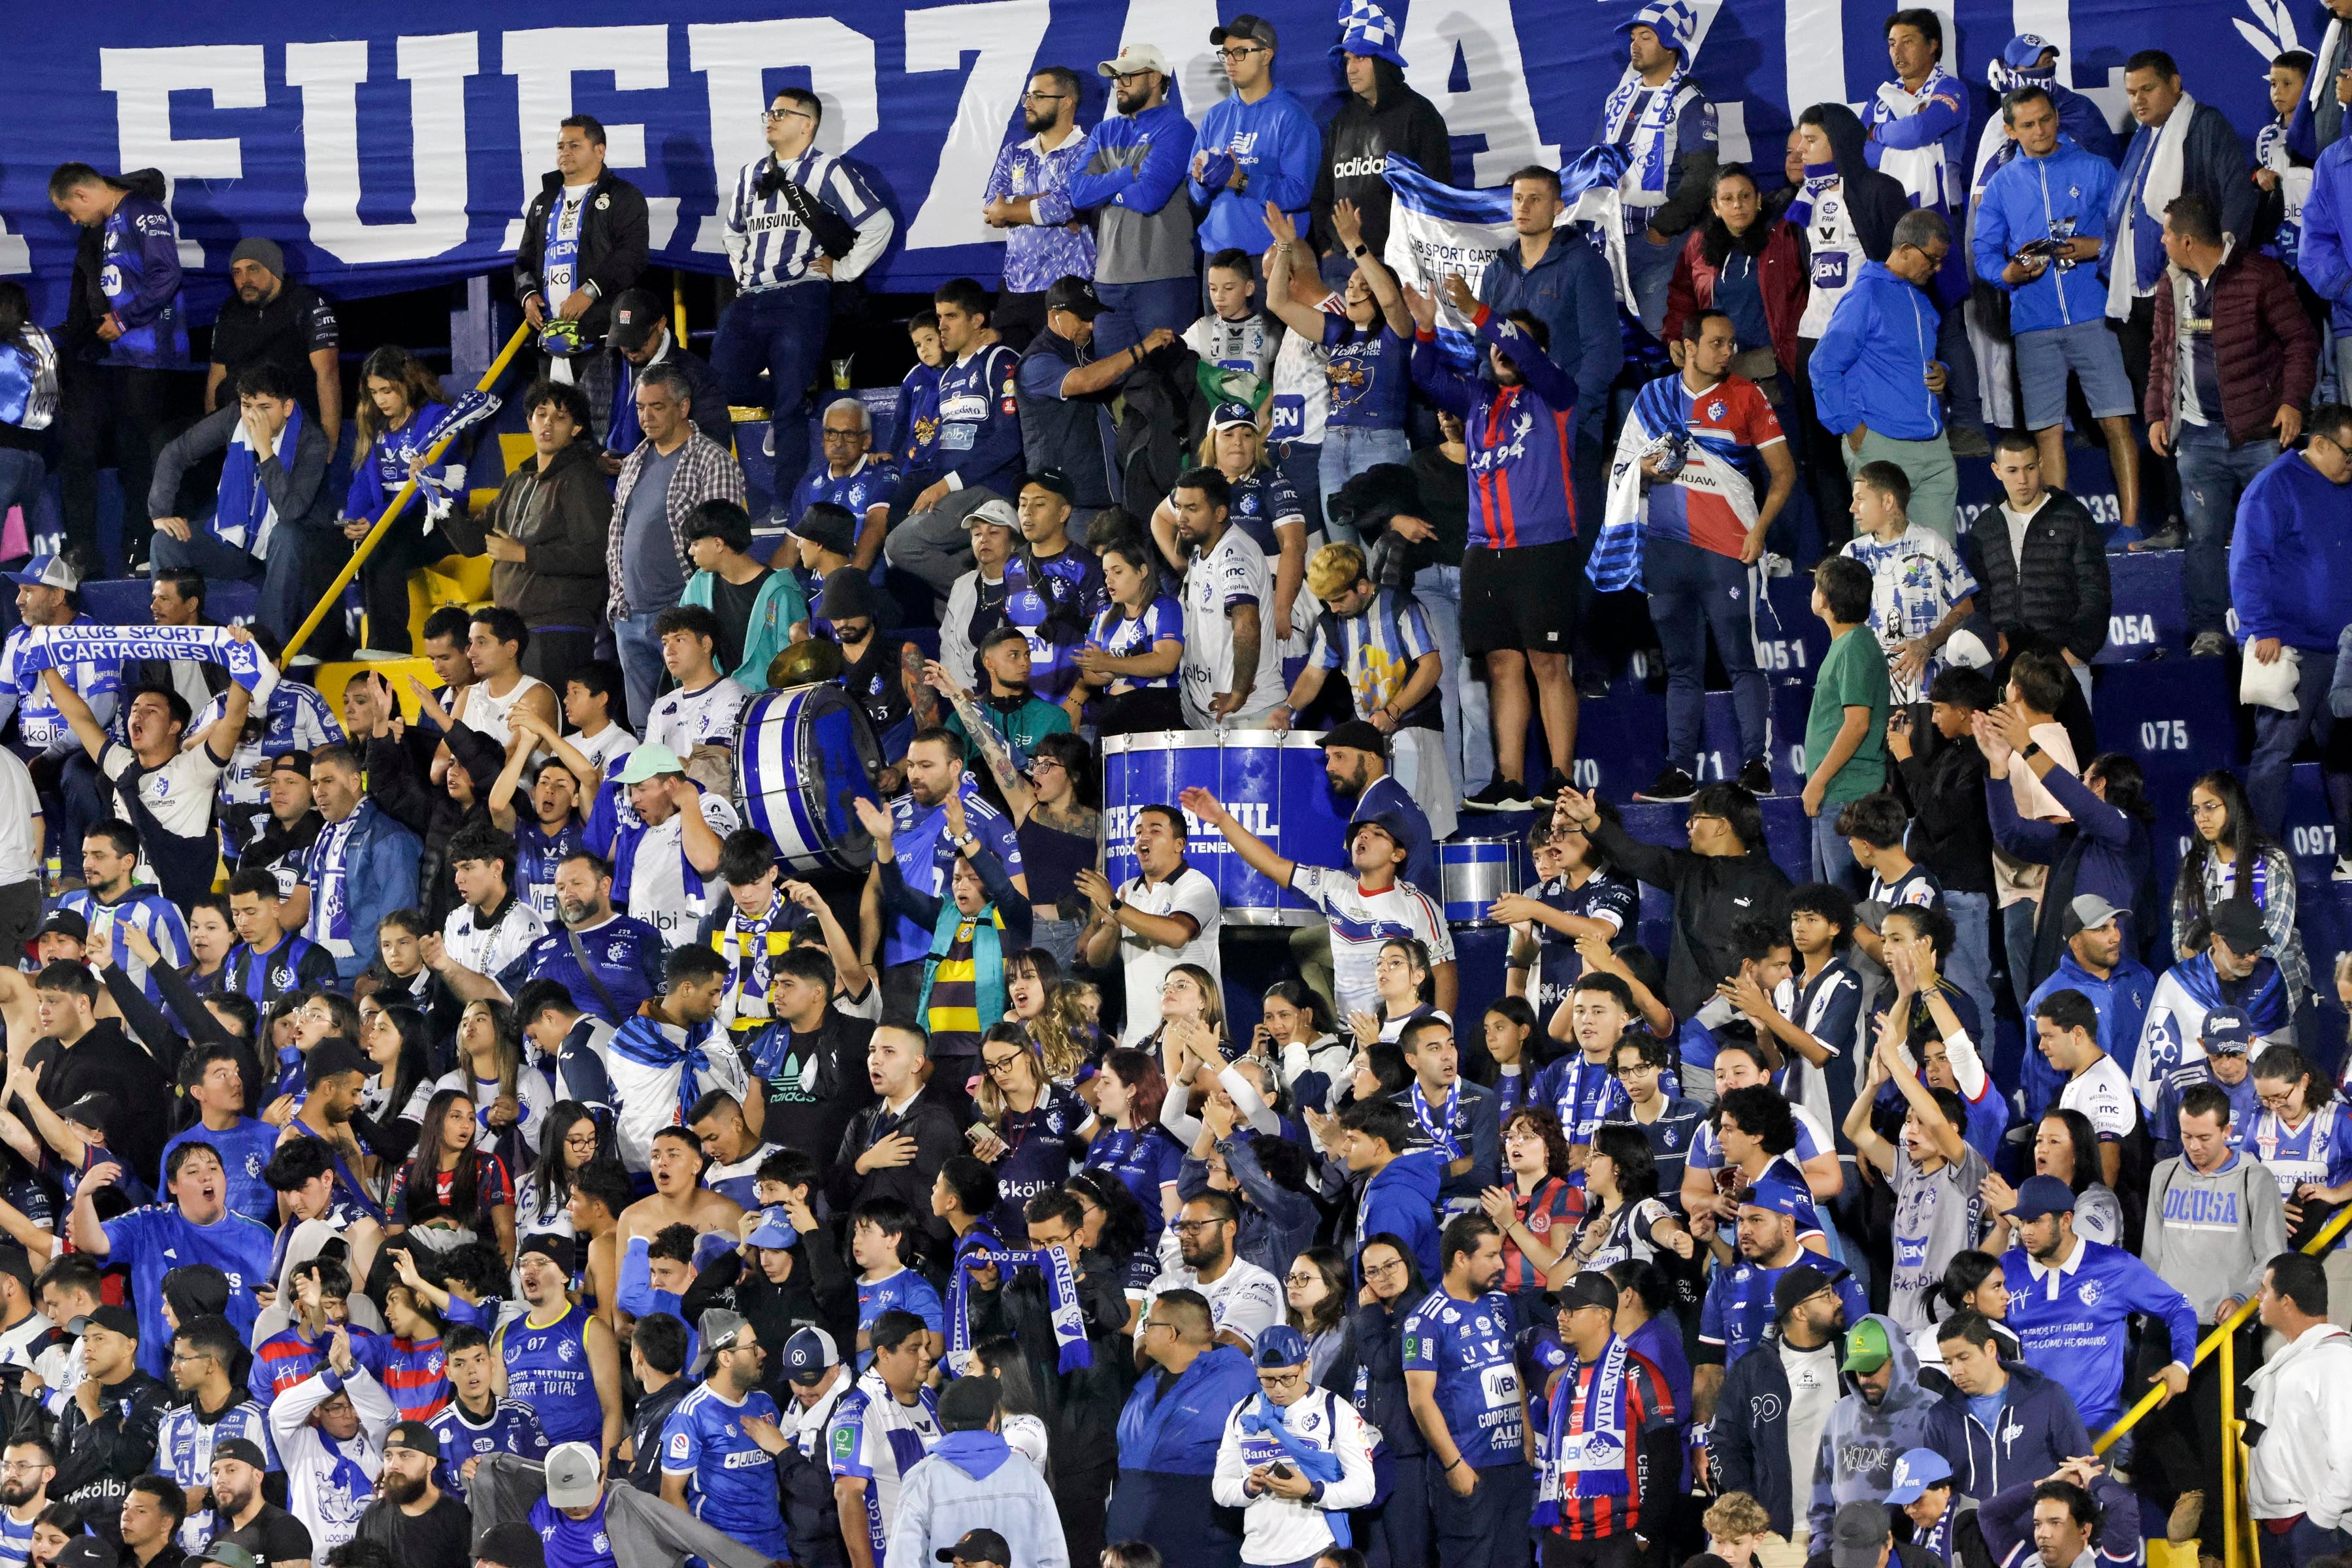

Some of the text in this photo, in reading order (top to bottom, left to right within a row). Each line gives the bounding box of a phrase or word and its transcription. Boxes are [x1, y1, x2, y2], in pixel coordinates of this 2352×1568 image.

[1426, 243, 1465, 262] SPORT
[1820, 261, 1842, 276] BN
[1470, 436, 1526, 469] LA 94
[2076, 494, 2121, 523] 33
[58, 626, 205, 640] CLUB SPORT
[2108, 614, 2156, 645] 054
[57, 641, 209, 662] CARTAGINES
[1760, 639, 1806, 670] 051
[2142, 720, 2189, 751] 075
[148, 798, 176, 808] VillaPlants
[2293, 825, 2337, 857] 097
[600, 962, 632, 971] VillaPlants
[2099, 1105, 2120, 1114] rnc
[1119, 1164, 1146, 1175] VillaPlants
[1903, 1244, 1925, 1258] BN
[2063, 1322, 2094, 1333] FAMILIA
[527, 1336, 547, 1351] 07
[2038, 1335, 2107, 1349] COMO HERMANOS
[1603, 1343, 1624, 1382] VIVE
[543, 1380, 578, 1397] TOTAL
[80, 1478, 126, 1500] kölbi
[868, 1498, 886, 1550] CELCO
